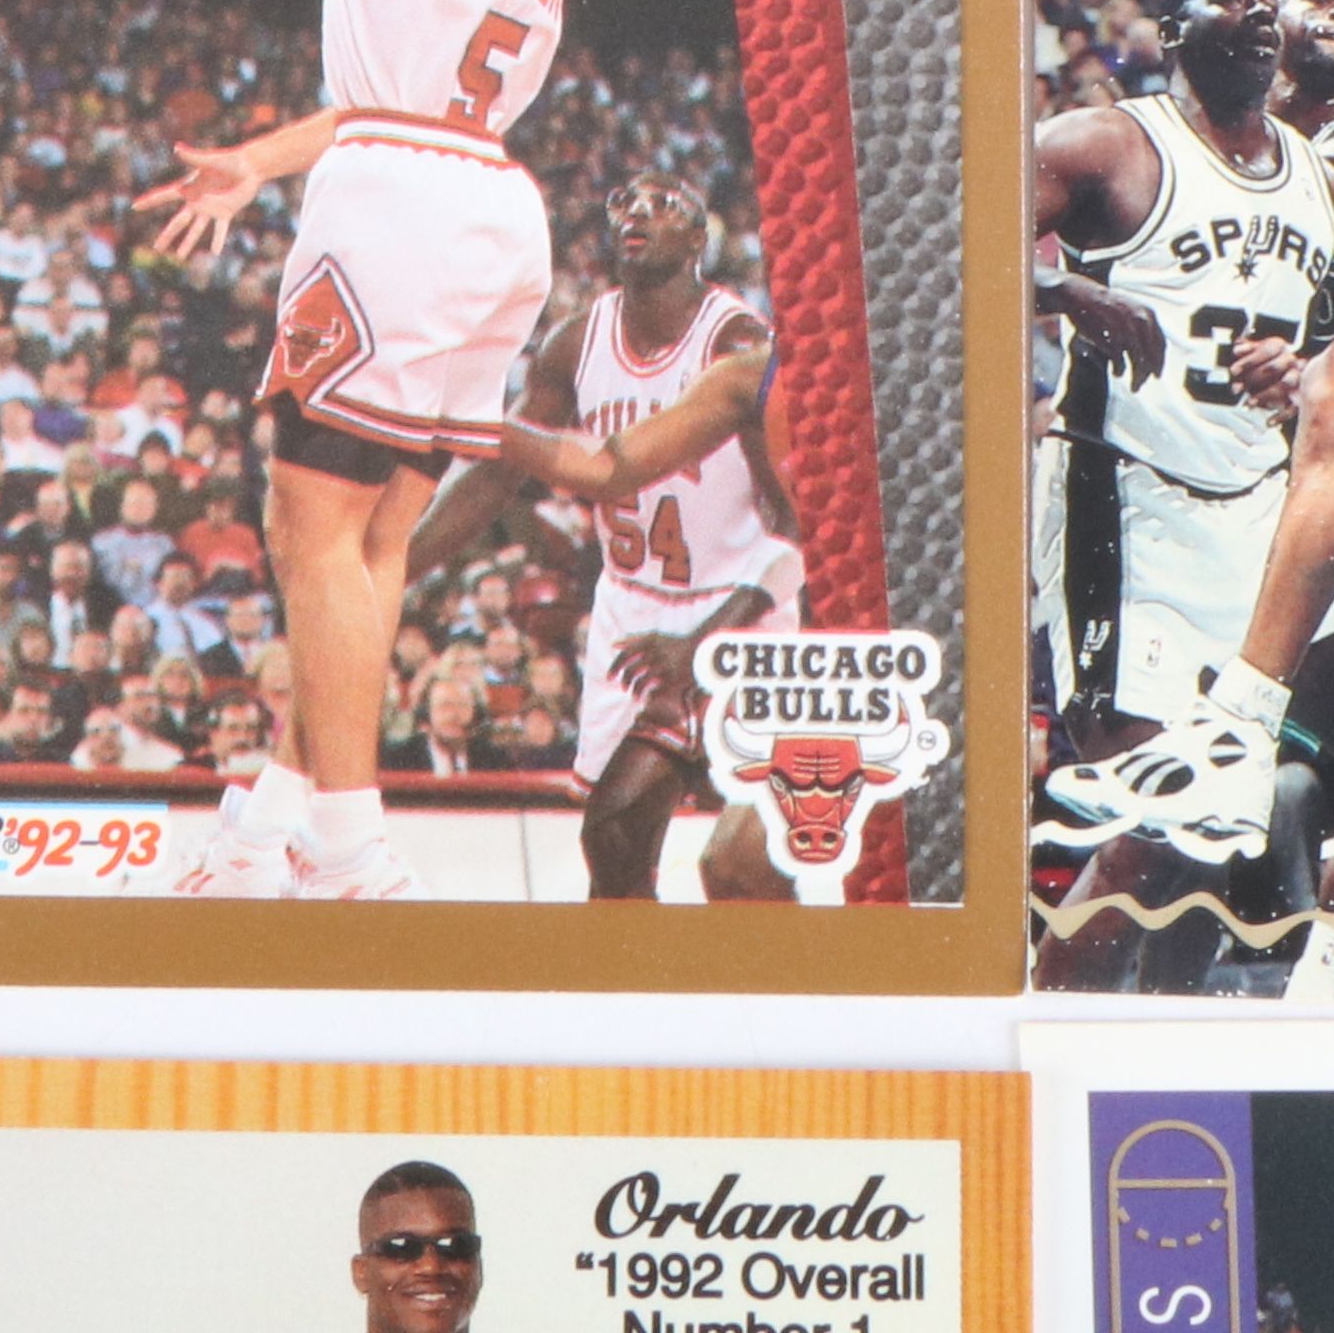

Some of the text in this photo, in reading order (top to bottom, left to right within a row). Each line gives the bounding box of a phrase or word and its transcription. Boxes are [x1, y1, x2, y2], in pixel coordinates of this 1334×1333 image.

[445, 9, 531, 133] 5
[1183, 303, 1301, 407] 3
[712, 641, 927, 681] CHICAGO
[741, 685, 891, 722] BULLS
[593, 1170, 925, 1242] Orlando
[740, 1252, 925, 1302] Overall
